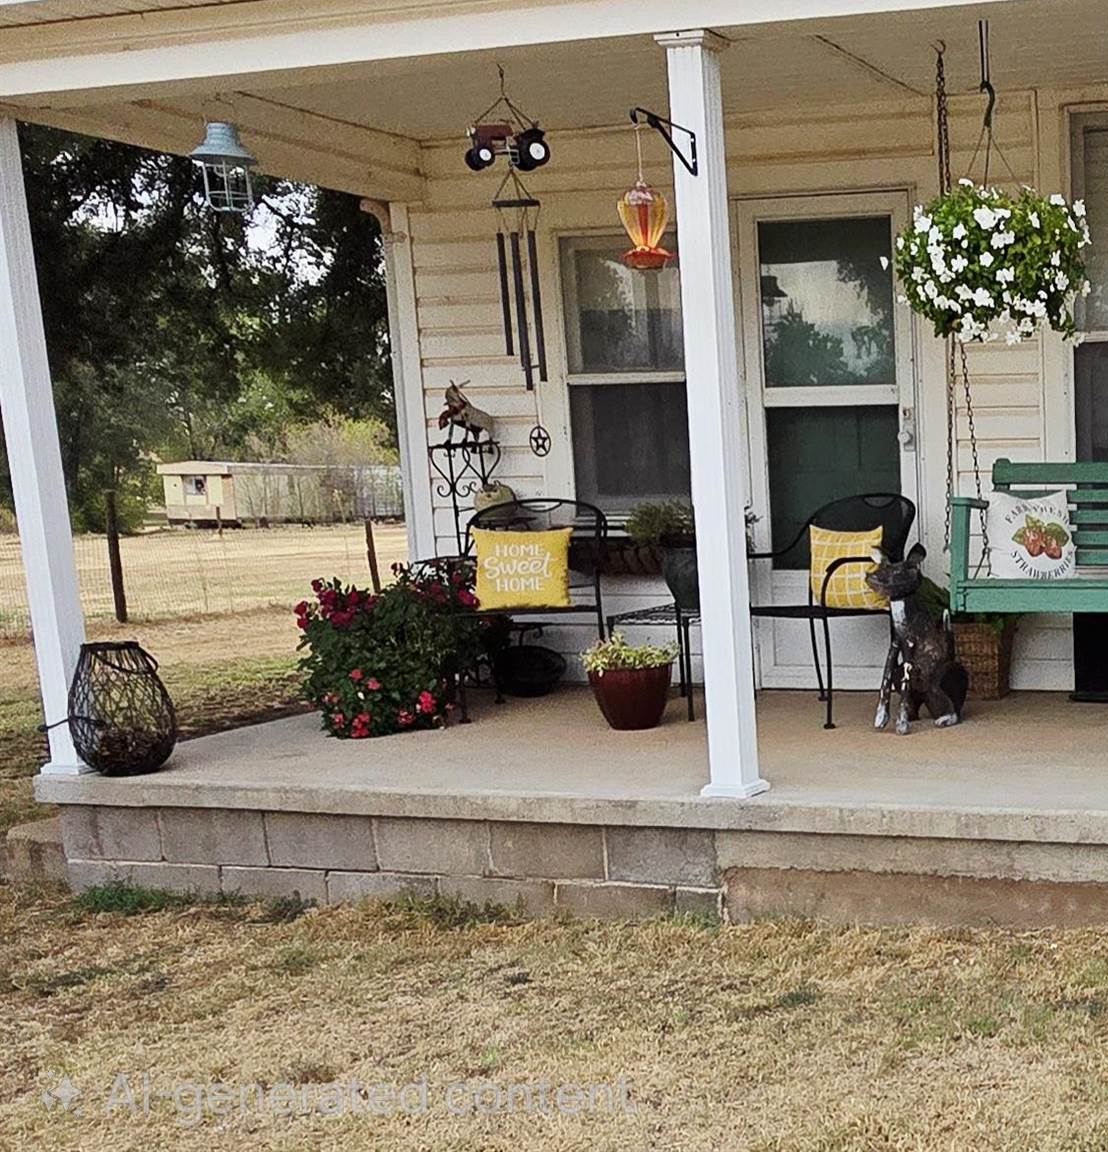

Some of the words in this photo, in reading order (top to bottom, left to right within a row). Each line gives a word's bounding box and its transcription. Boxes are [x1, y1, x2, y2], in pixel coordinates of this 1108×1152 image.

[495, 544, 546, 558] HOME
[484, 553, 559, 579] Sweet
[495, 578, 546, 593] HOME
